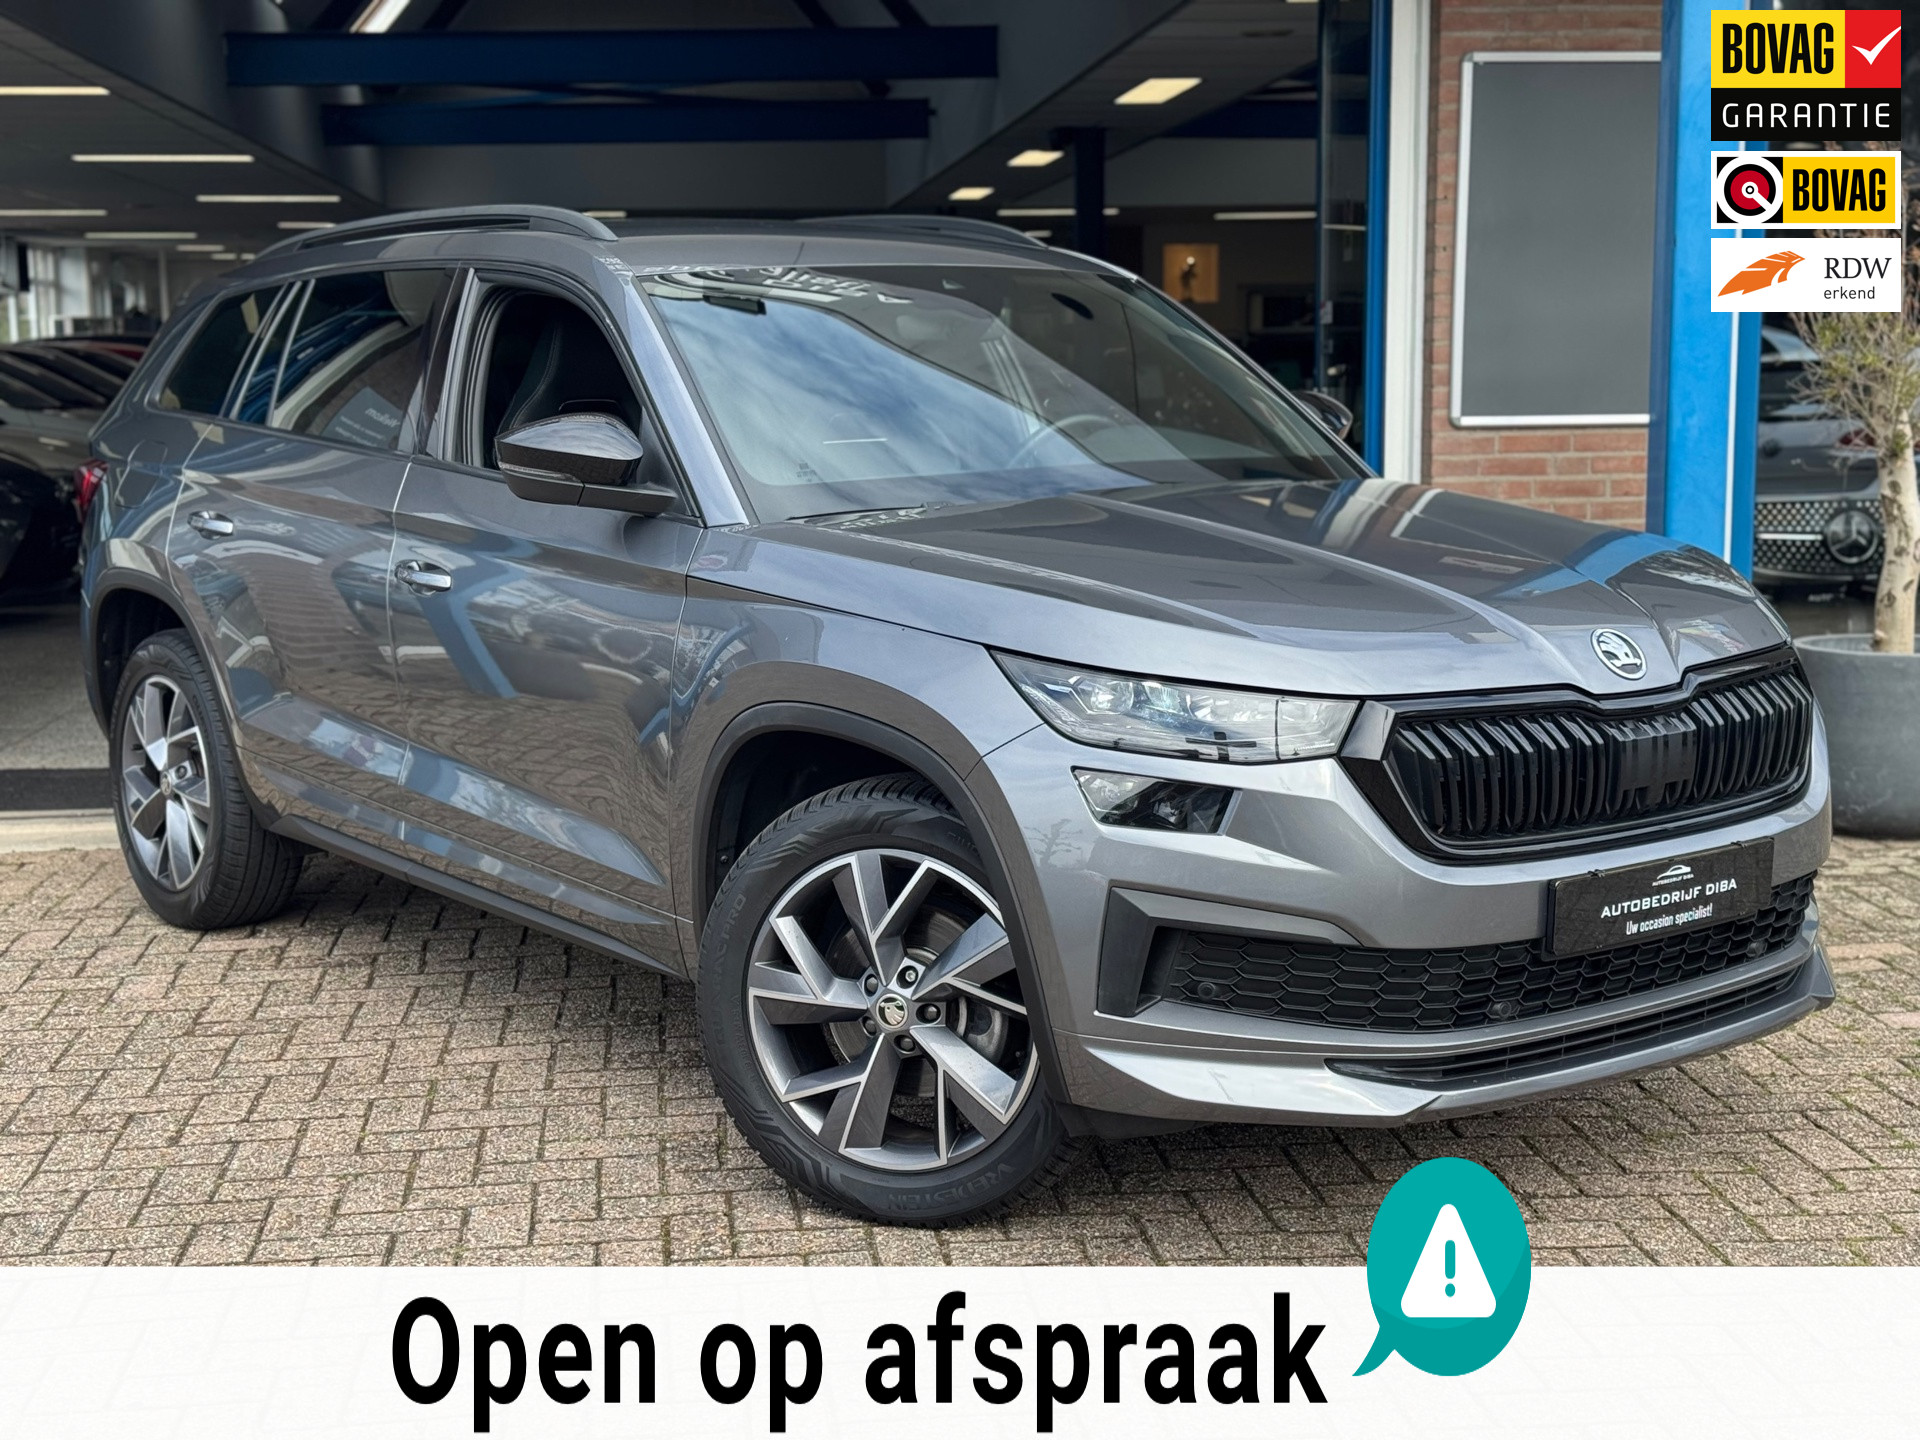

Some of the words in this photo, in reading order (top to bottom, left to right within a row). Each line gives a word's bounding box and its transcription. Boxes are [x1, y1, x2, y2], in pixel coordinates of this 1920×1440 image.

[720, 893, 747, 940] PRO
[1600, 886, 1702, 919] AUTOBEDRIJF
[1705, 878, 1737, 896] DIBA
[1626, 920, 1638, 935] Uw
[1640, 914, 1673, 932] occasion
[1675, 902, 1713, 925] specialist!
